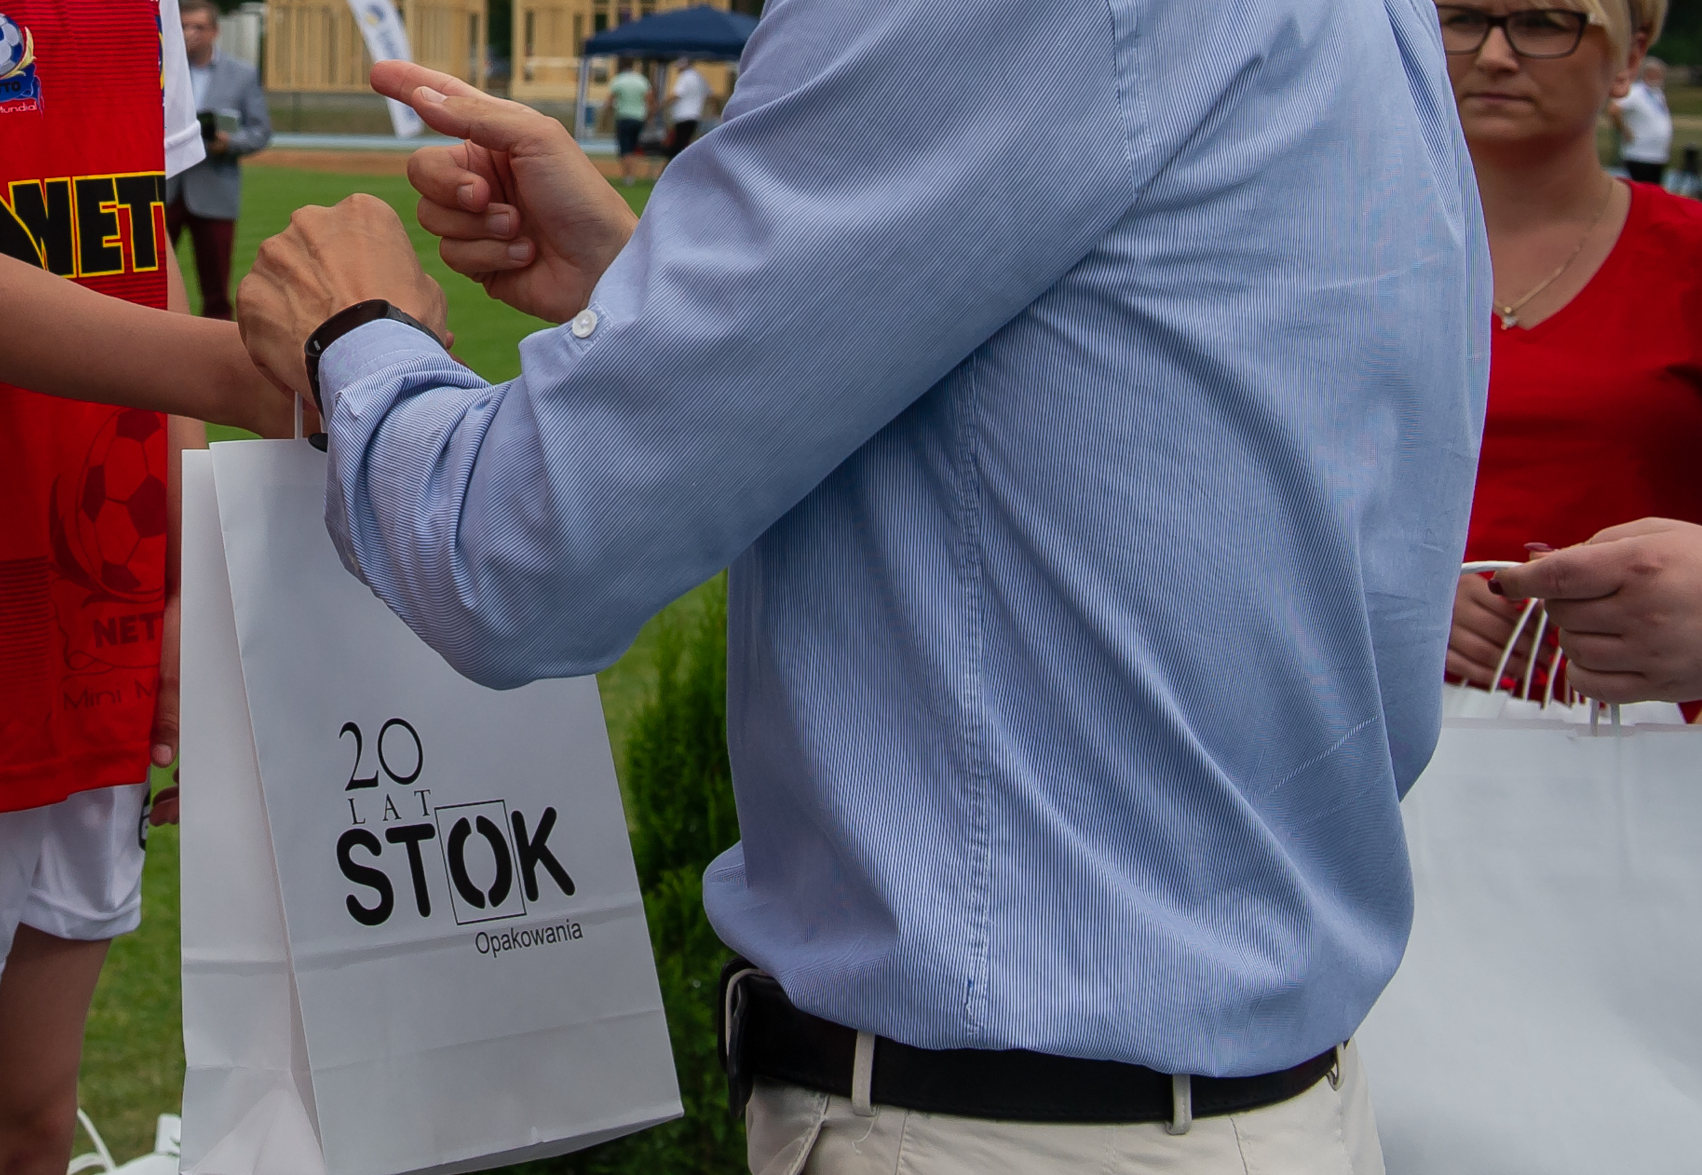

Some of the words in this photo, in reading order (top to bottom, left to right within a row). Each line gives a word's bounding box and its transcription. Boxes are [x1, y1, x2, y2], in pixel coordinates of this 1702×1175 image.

[62, 683, 123, 710] Mini
[338, 717, 424, 792] 20
[348, 789, 432, 825] LAT
[336, 806, 576, 927] STOK
[474, 919, 584, 958] Opakowania
